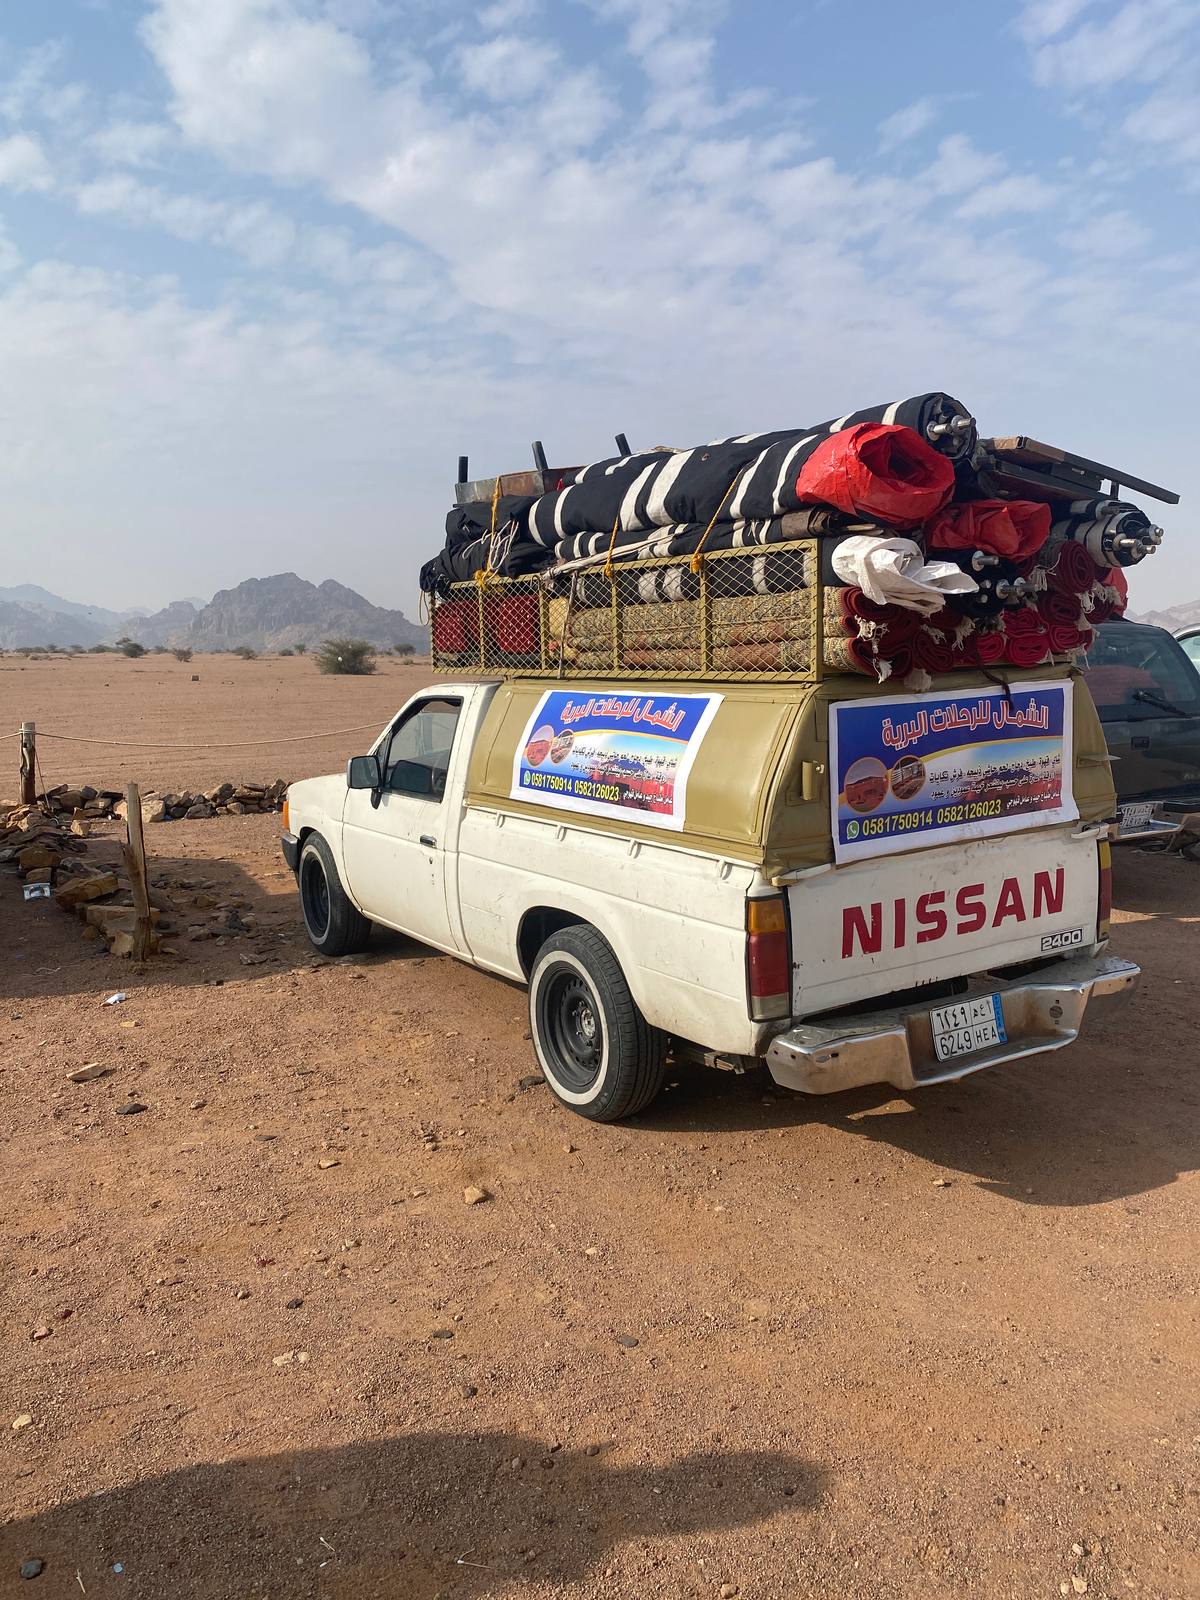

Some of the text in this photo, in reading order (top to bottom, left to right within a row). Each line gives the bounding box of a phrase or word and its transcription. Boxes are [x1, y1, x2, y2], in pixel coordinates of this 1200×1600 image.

[560, 697, 686, 732] الشمال للرحلات البرية
[882, 698, 1048, 751] الشمال للرحلات البرية
[531, 771, 619, 802] 0581750914 0582126023
[862, 799, 1002, 836] 0581750914 0582126023
[841, 868, 1065, 959] NISSAN
[1042, 930, 1082, 950] 2400
[940, 1025, 997, 1056] 6249 HEA
